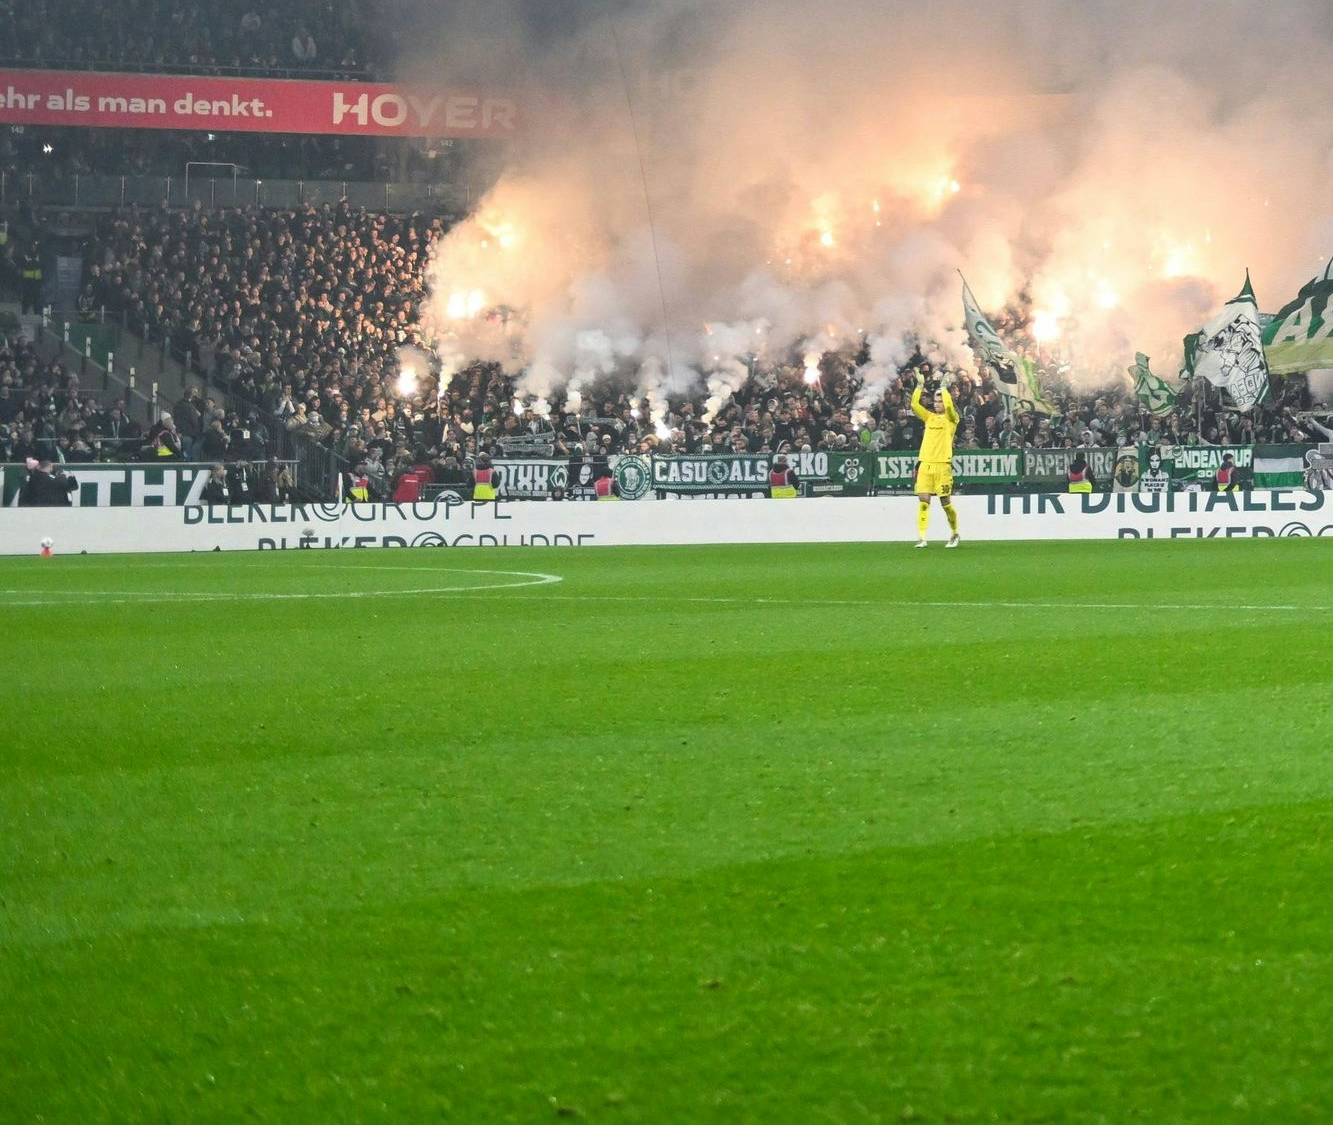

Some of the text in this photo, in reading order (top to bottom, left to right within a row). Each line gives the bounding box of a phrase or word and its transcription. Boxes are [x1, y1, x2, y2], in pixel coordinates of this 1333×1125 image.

[46, 88, 90, 112] als
[98, 95, 167, 114] man
[174, 92, 273, 118] denkt.
[332, 91, 516, 130] HOYER
[1025, 451, 1114, 475] PAPENURG
[1175, 449, 1253, 469] ENDEAVUR
[941, 485, 950, 494] 30
